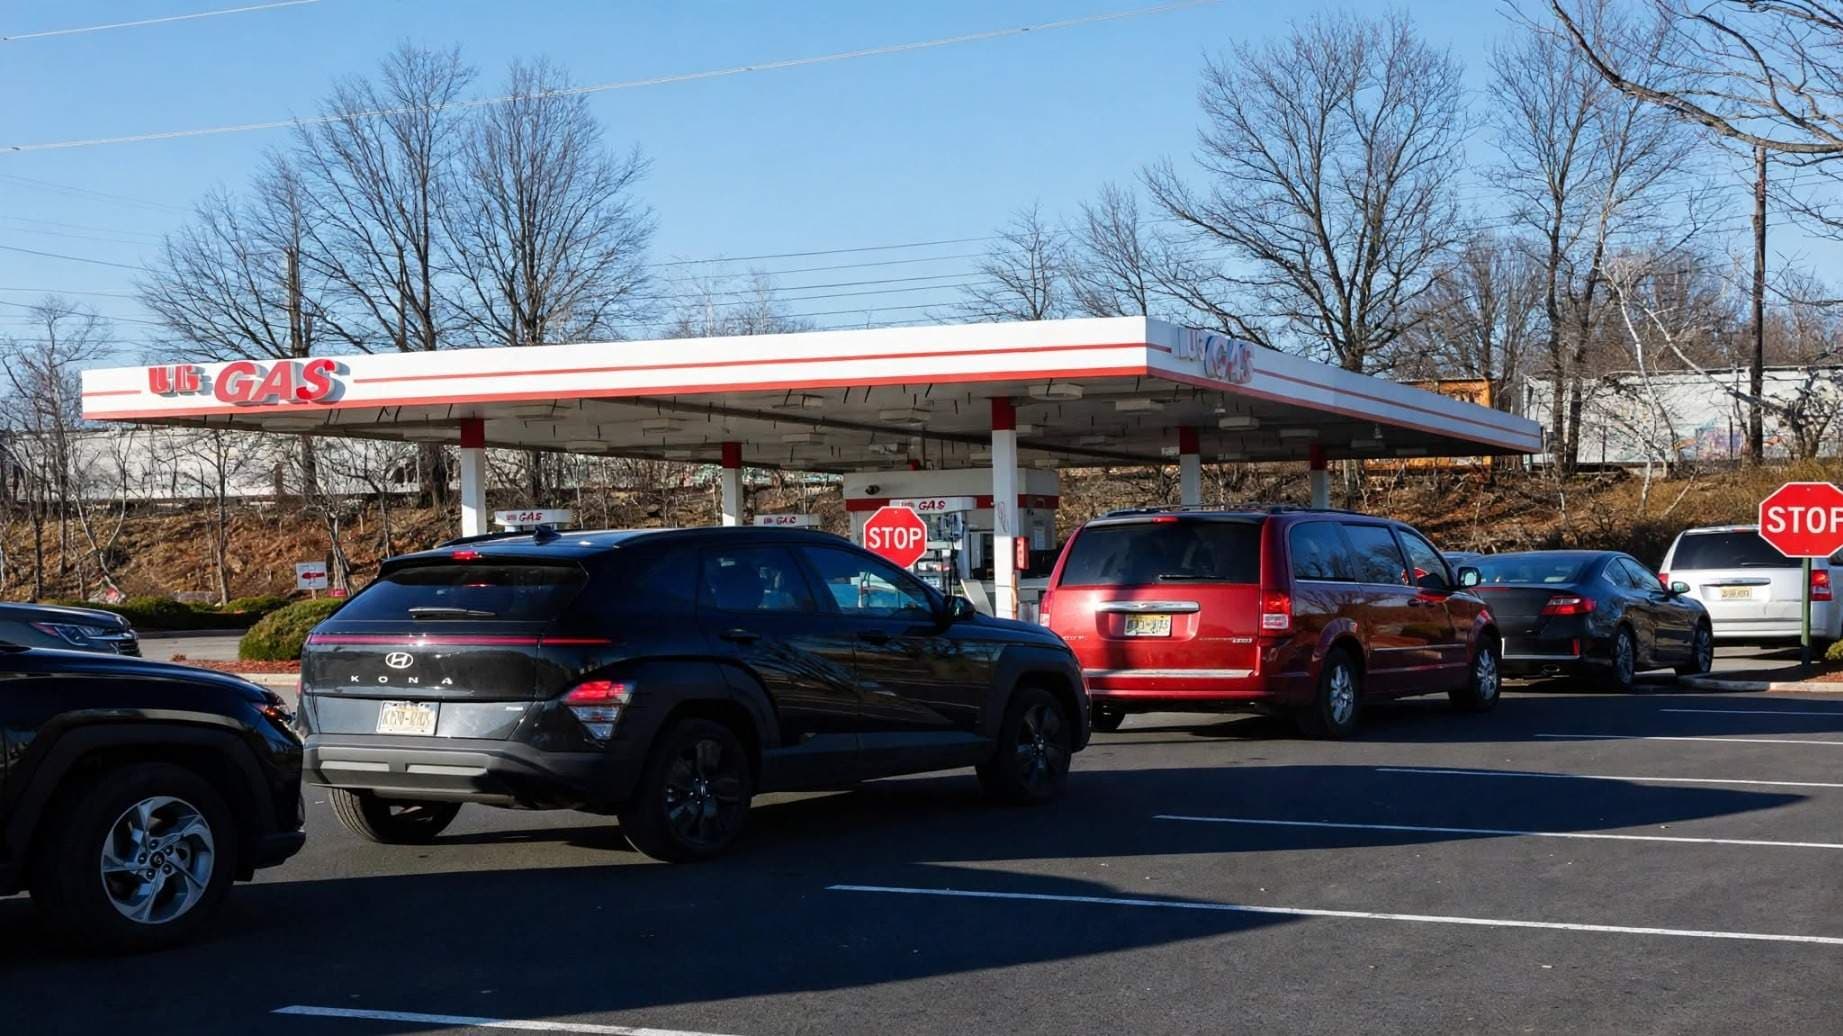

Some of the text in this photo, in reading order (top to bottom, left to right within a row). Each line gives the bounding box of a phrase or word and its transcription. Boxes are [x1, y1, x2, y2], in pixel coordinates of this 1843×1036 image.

[214, 358, 344, 406] GAS
[919, 500, 946, 511] GAS
[868, 526, 922, 549] STOP
[350, 675, 453, 685] KONA
